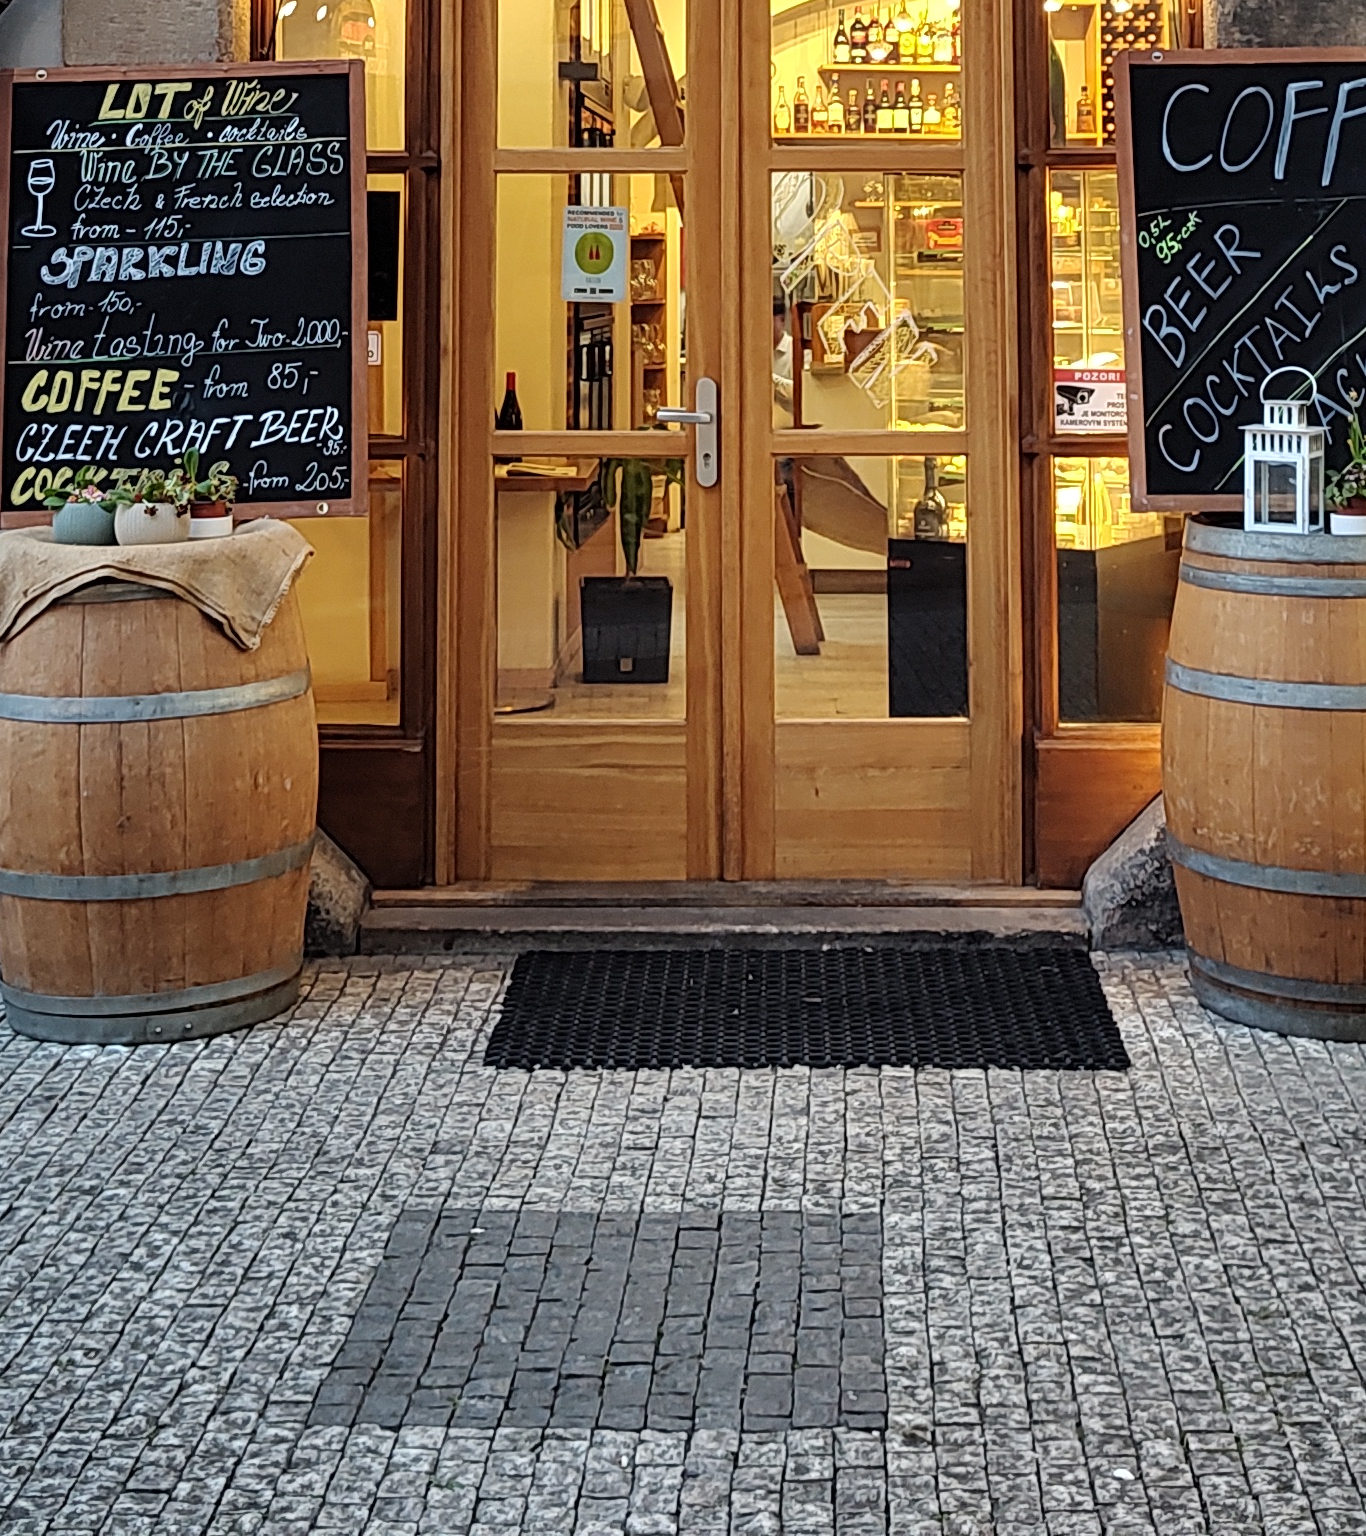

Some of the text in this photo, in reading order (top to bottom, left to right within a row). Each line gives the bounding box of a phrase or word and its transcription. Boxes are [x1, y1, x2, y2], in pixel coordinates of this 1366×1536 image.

[98, 78, 299, 130] LOT of Wine
[46, 117, 308, 151] Wine Coffee cocktails
[79, 141, 344, 184] Wine BY THE GLASS
[155, 193, 165, 208] &
[174, 182, 243, 209] French
[70, 214, 121, 240] from
[40, 240, 267, 288] SPARKLING
[1142, 224, 1262, 368] BEER
[24, 327, 85, 361] Wine
[92, 313, 205, 367] tasting
[211, 318, 240, 353] for
[1159, 244, 1358, 472] COCKTAILS
[21, 367, 181, 415] COFFEE
[203, 364, 249, 399] from
[1074, 372, 1121, 381] POZOR!
[134, 414, 254, 458] CRAFT
[250, 406, 344, 449] BEER
